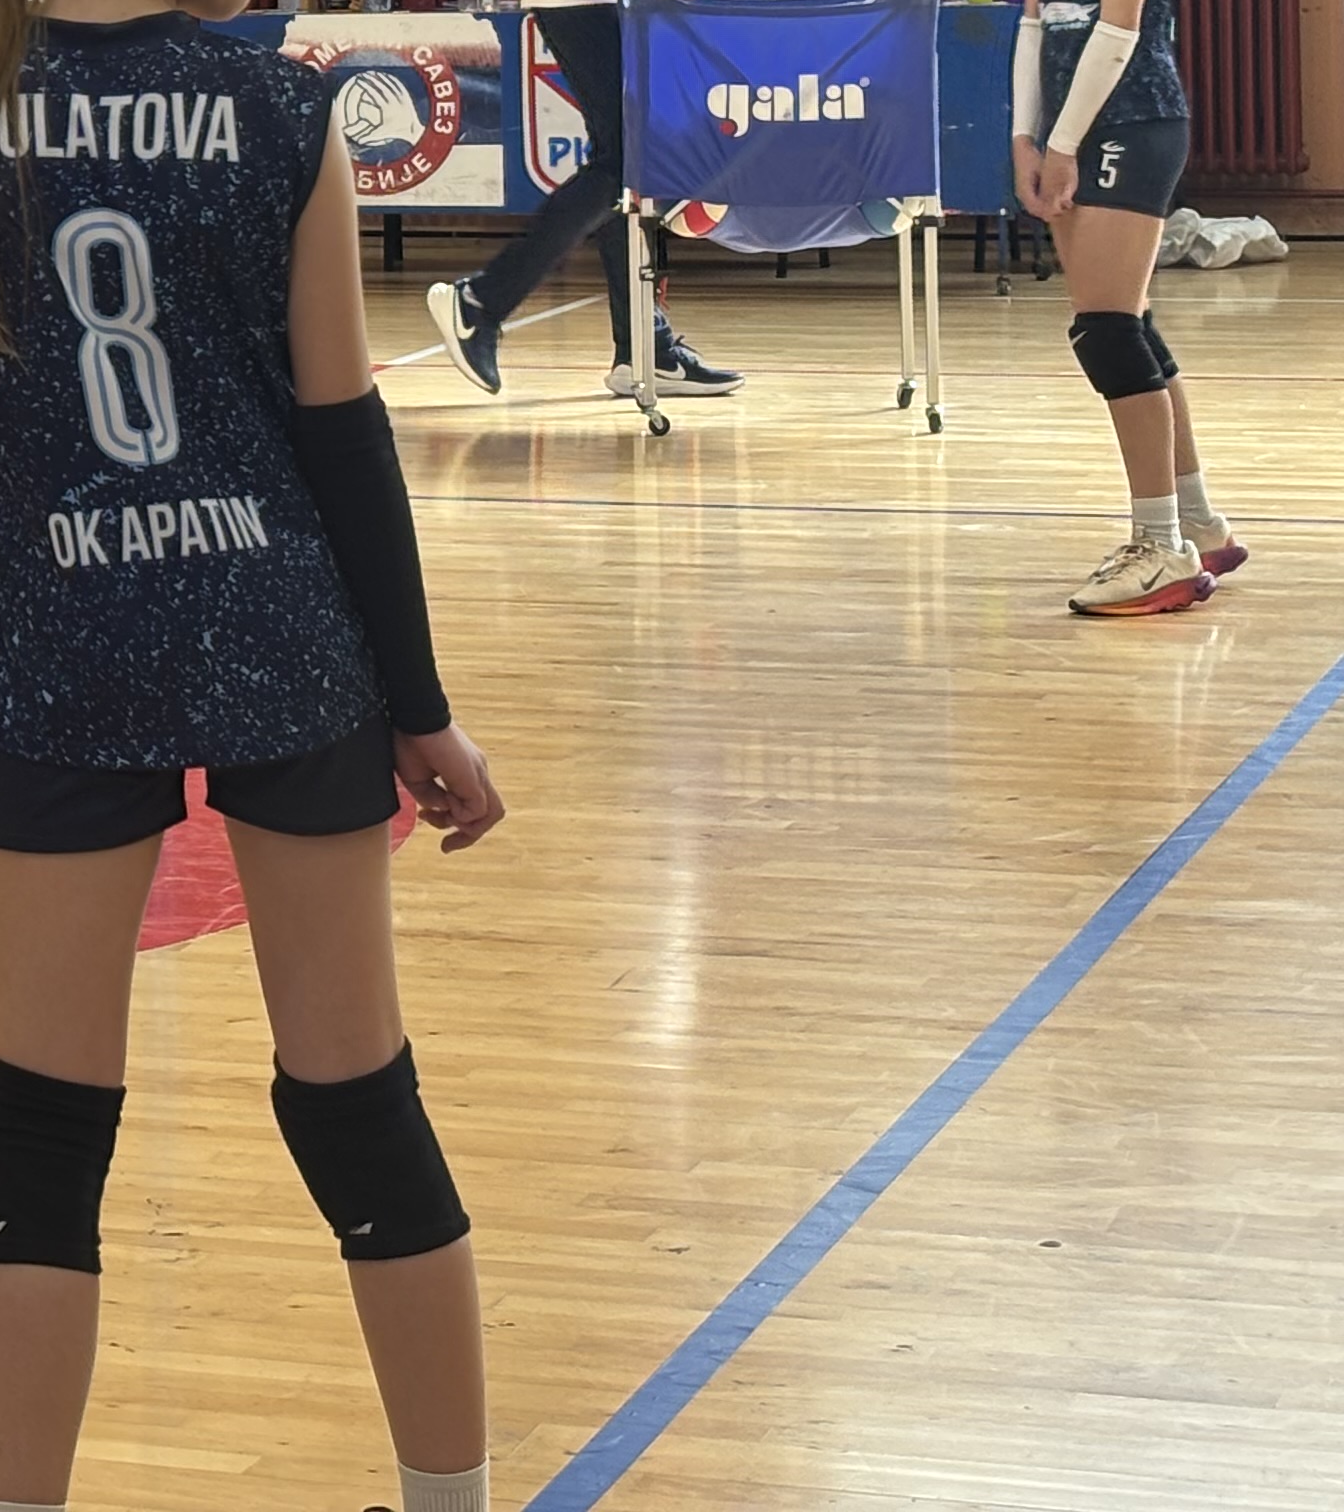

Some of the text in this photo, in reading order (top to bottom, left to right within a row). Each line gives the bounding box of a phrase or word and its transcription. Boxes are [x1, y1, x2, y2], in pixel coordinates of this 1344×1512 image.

[412, 45, 457, 135] САВЕЗ
[706, 74, 866, 138] gala
[357, 152, 433, 190] БИЈЕ
[1098, 154, 1120, 189] 5
[51, 206, 181, 467] 8
[48, 494, 270, 569] OK APATIN
